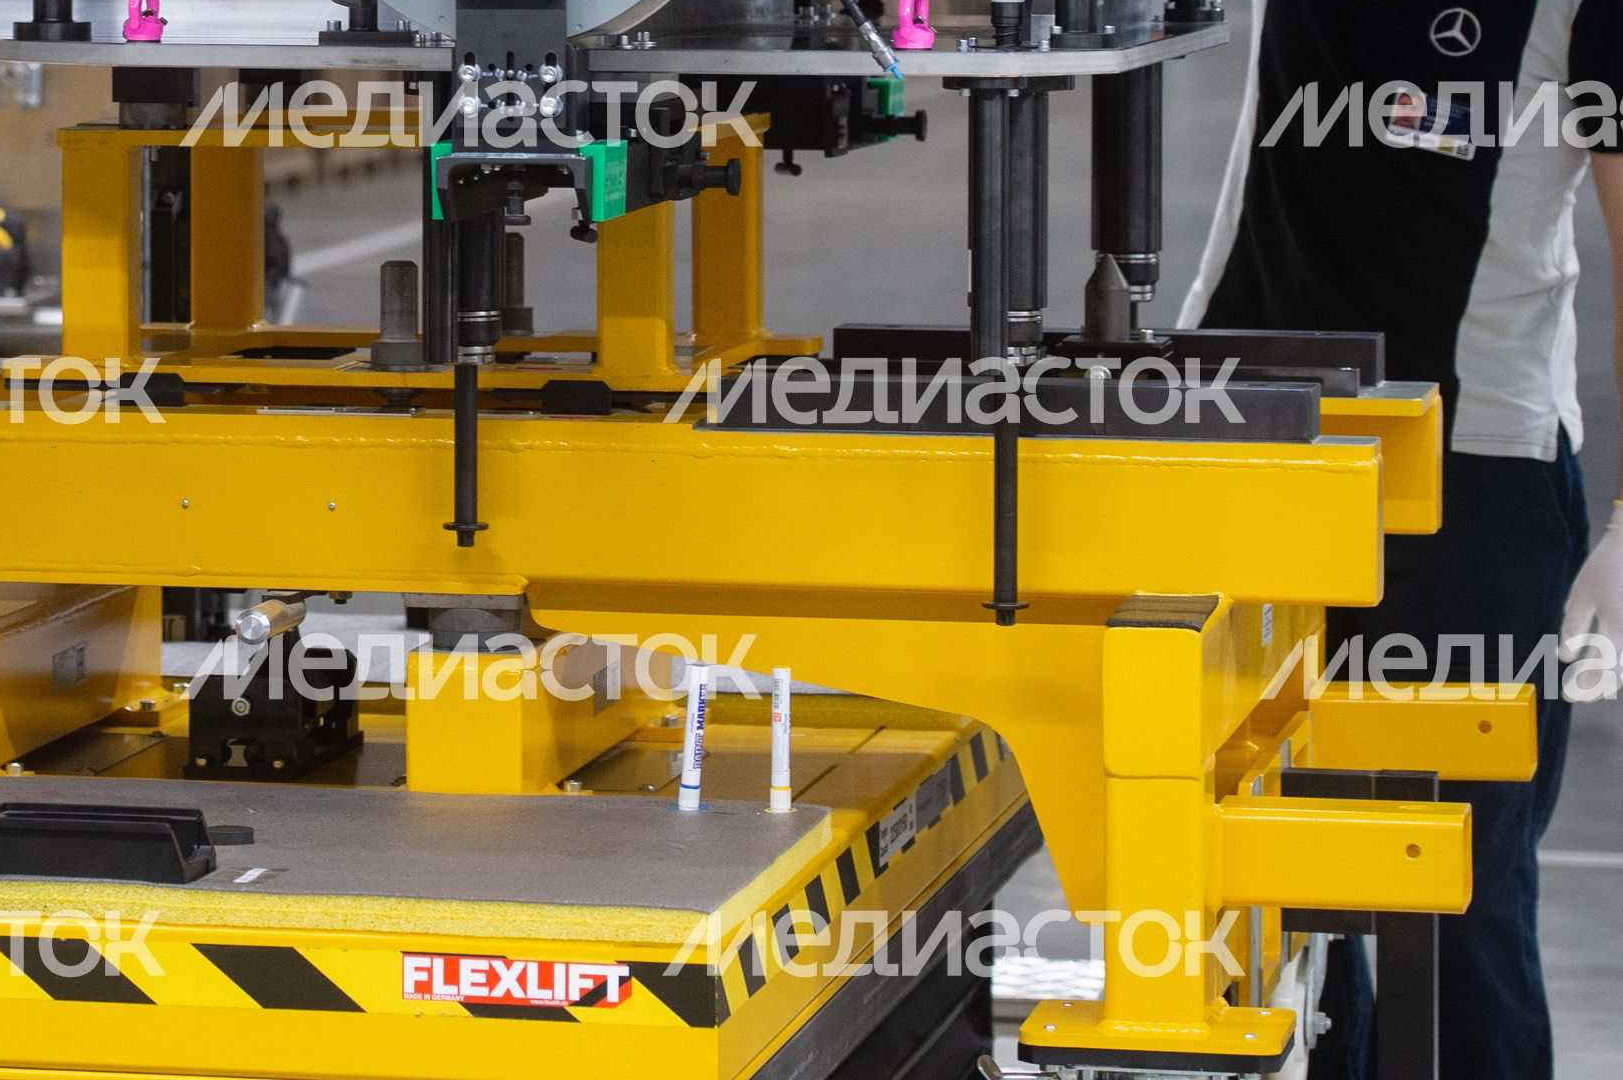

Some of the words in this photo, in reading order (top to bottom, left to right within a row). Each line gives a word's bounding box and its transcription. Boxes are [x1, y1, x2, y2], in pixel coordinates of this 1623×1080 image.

[696, 682, 708, 731] MARKER
[403, 955, 630, 1004] FLEXLIFT
[403, 993, 423, 1001] MADE
[431, 993, 465, 1002] GERMANY
